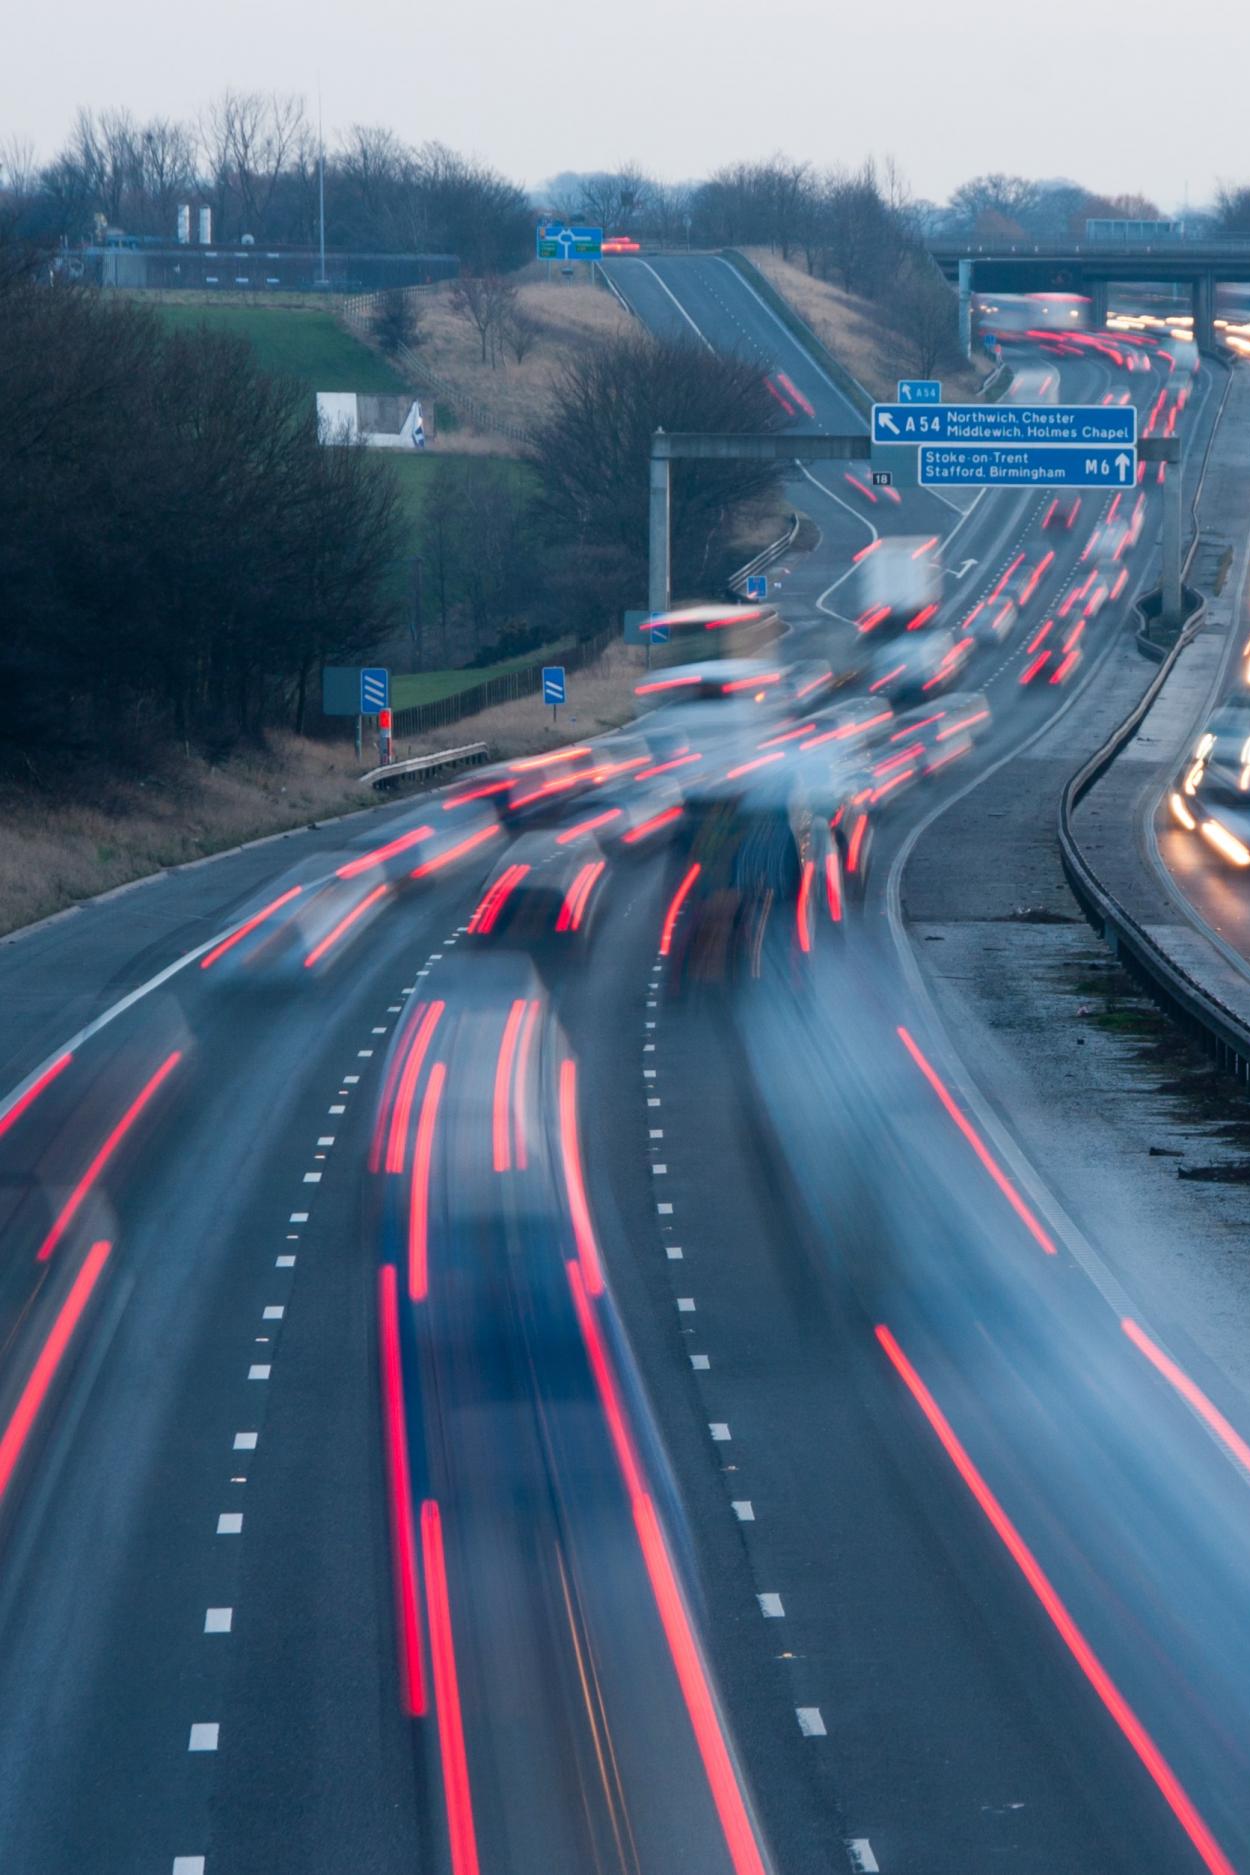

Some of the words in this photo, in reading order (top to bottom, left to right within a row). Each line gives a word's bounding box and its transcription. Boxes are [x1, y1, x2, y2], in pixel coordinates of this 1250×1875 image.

[947, 411, 1019, 423] Northwich,
[1022, 411, 1075, 424] Chester
[947, 426, 1024, 438] Middlewich,
[1027, 427, 1077, 438] Holmes
[1082, 427, 1129, 440] Chapel
[926, 451, 1029, 463] Stoke-on-Trent
[876, 474, 888, 484] 18
[926, 465, 986, 478] Stafford,
[990, 467, 1066, 480] Birmingham
